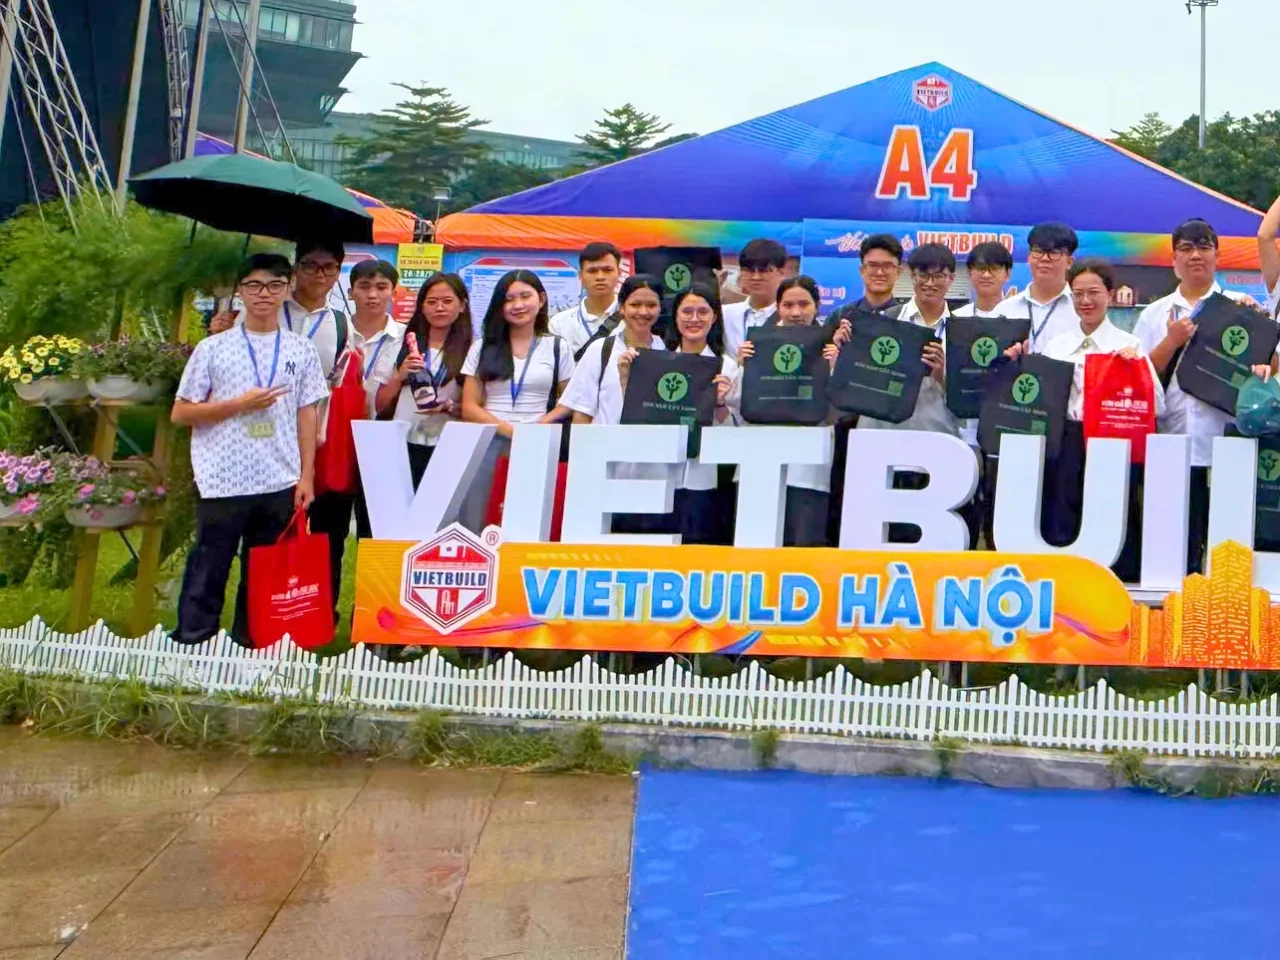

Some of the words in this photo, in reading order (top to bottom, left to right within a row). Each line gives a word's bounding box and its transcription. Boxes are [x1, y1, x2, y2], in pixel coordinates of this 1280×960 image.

[875, 124, 977, 201] A4
[413, 570, 488, 587] VIETBUILD
[521, 566, 822, 628] VIETBUILD
[838, 562, 925, 630] HÀ
[935, 563, 1056, 646] NỘI
